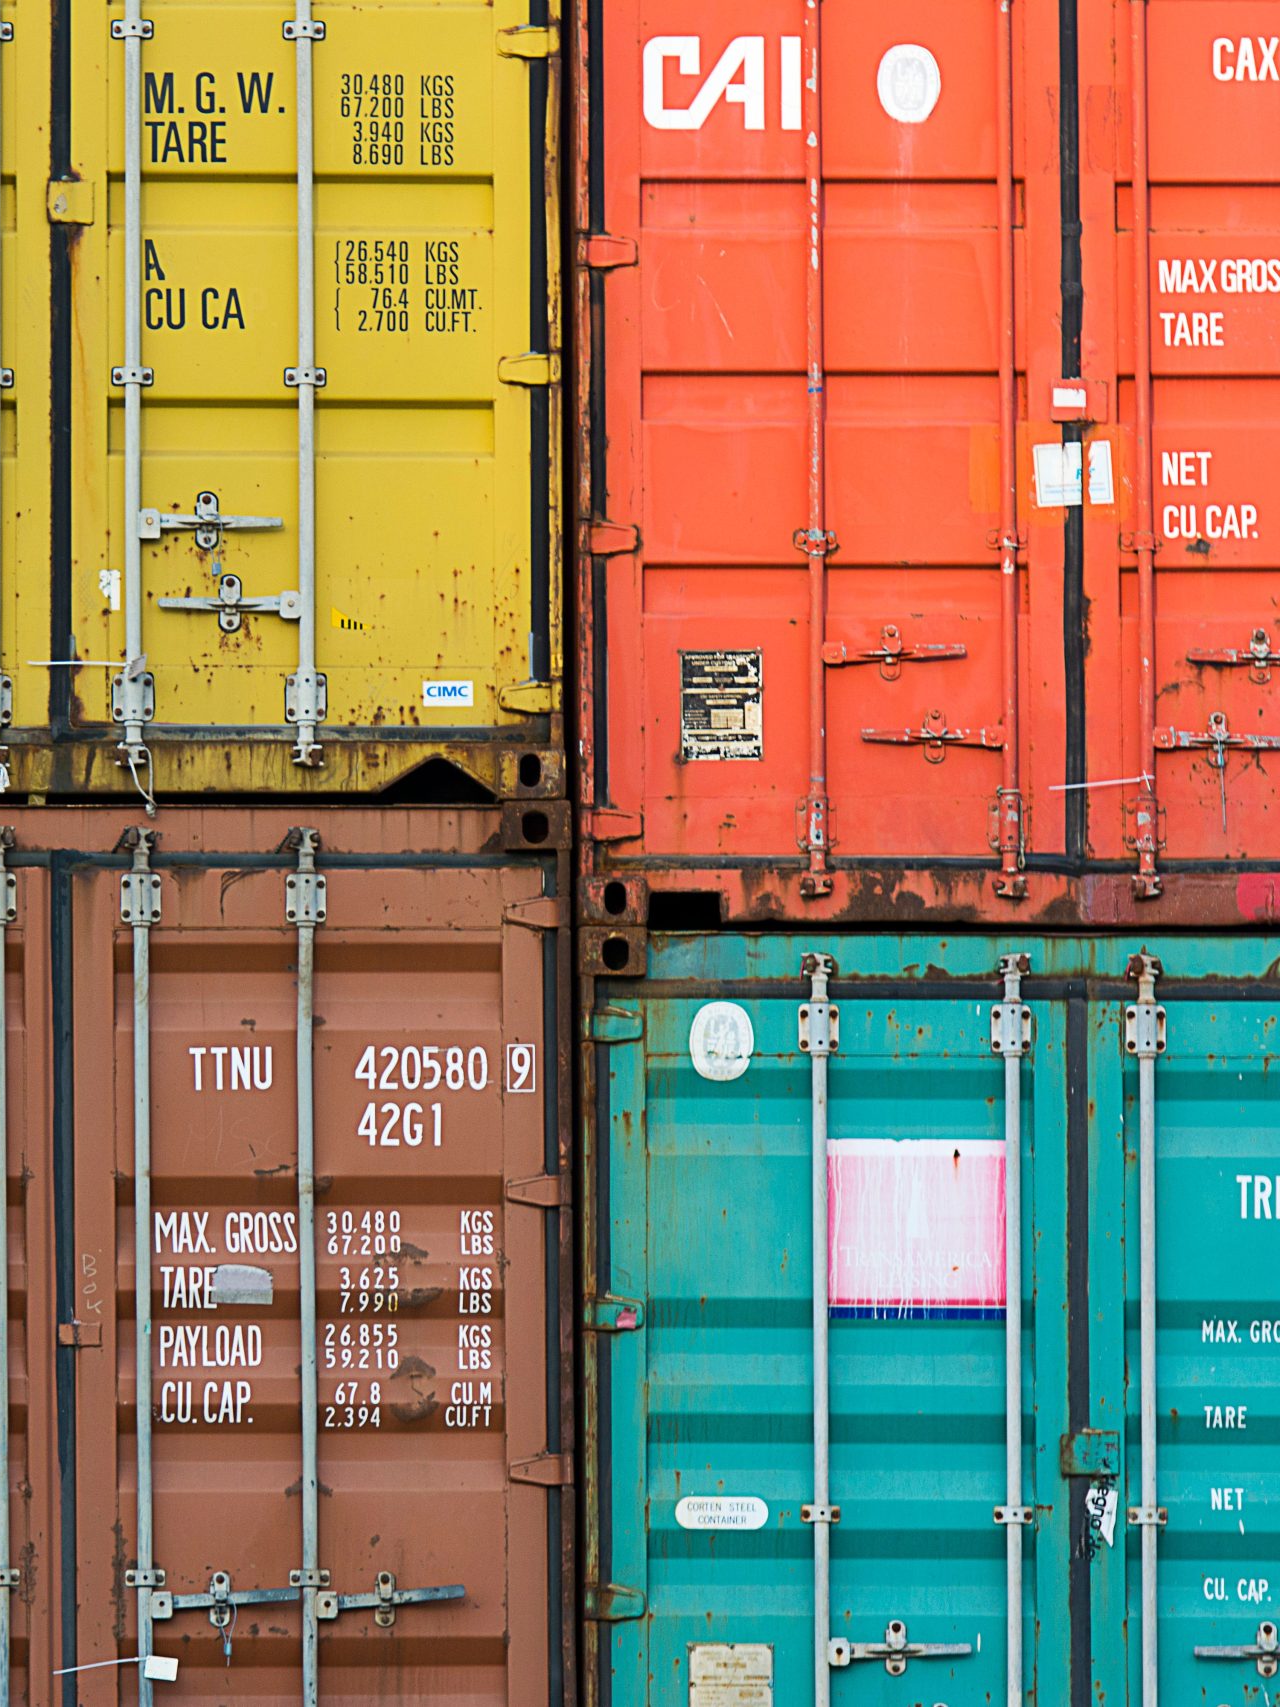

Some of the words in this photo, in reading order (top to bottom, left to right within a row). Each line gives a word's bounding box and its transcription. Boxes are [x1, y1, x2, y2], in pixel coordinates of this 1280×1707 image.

[1212, 36, 1280, 81] CAX
[144, 72, 185, 114] M.
[195, 72, 226, 114] G.
[237, 72, 285, 114] W.
[420, 75, 454, 96] KGS
[643, 35, 802, 130] CAI
[420, 98, 454, 119] LBS
[145, 121, 227, 163] TARE
[420, 122, 454, 143] KGS
[420, 145, 454, 166] LBS
[425, 241, 459, 263] KGS
[425, 264, 459, 285] LBS
[1158, 259, 1217, 293] MAX
[145, 287, 186, 330] CU
[201, 287, 246, 330] CA
[371, 288, 409, 309] 76.4
[1159, 312, 1224, 346] TARE
[1162, 451, 1212, 486] NET
[426, 685, 468, 697] CIMC
[189, 1046, 273, 1091] TTNU
[355, 1046, 488, 1091] 420580
[511, 1046, 531, 1090] 9
[358, 1102, 442, 1146] 42G1
[155, 1212, 216, 1254] MAX.
[225, 1212, 298, 1254] GROSS
[460, 1211, 494, 1233] KGS
[460, 1235, 494, 1255] LBS
[160, 1266, 218, 1309] TARE
[459, 1267, 493, 1290] KGS
[459, 1292, 492, 1313] LBS
[458, 1325, 492, 1348] KGS
[1201, 1320, 1242, 1343] MAX.
[160, 1325, 262, 1367] PAYLOAD
[458, 1349, 492, 1370] LBS
[335, 1382, 381, 1405] 67.8
[451, 1382, 492, 1405] CU.M
[445, 1406, 492, 1428] CU.FT
[1204, 1406, 1247, 1429] TARE
[687, 1502, 722, 1512] CORTEN
[729, 1502, 757, 1512] STEEL
[1210, 1488, 1244, 1511] NET
[697, 1515, 747, 1525] CONTAINER
[1203, 1578, 1229, 1601] CU.
[1237, 1578, 1272, 1602] CAP.
